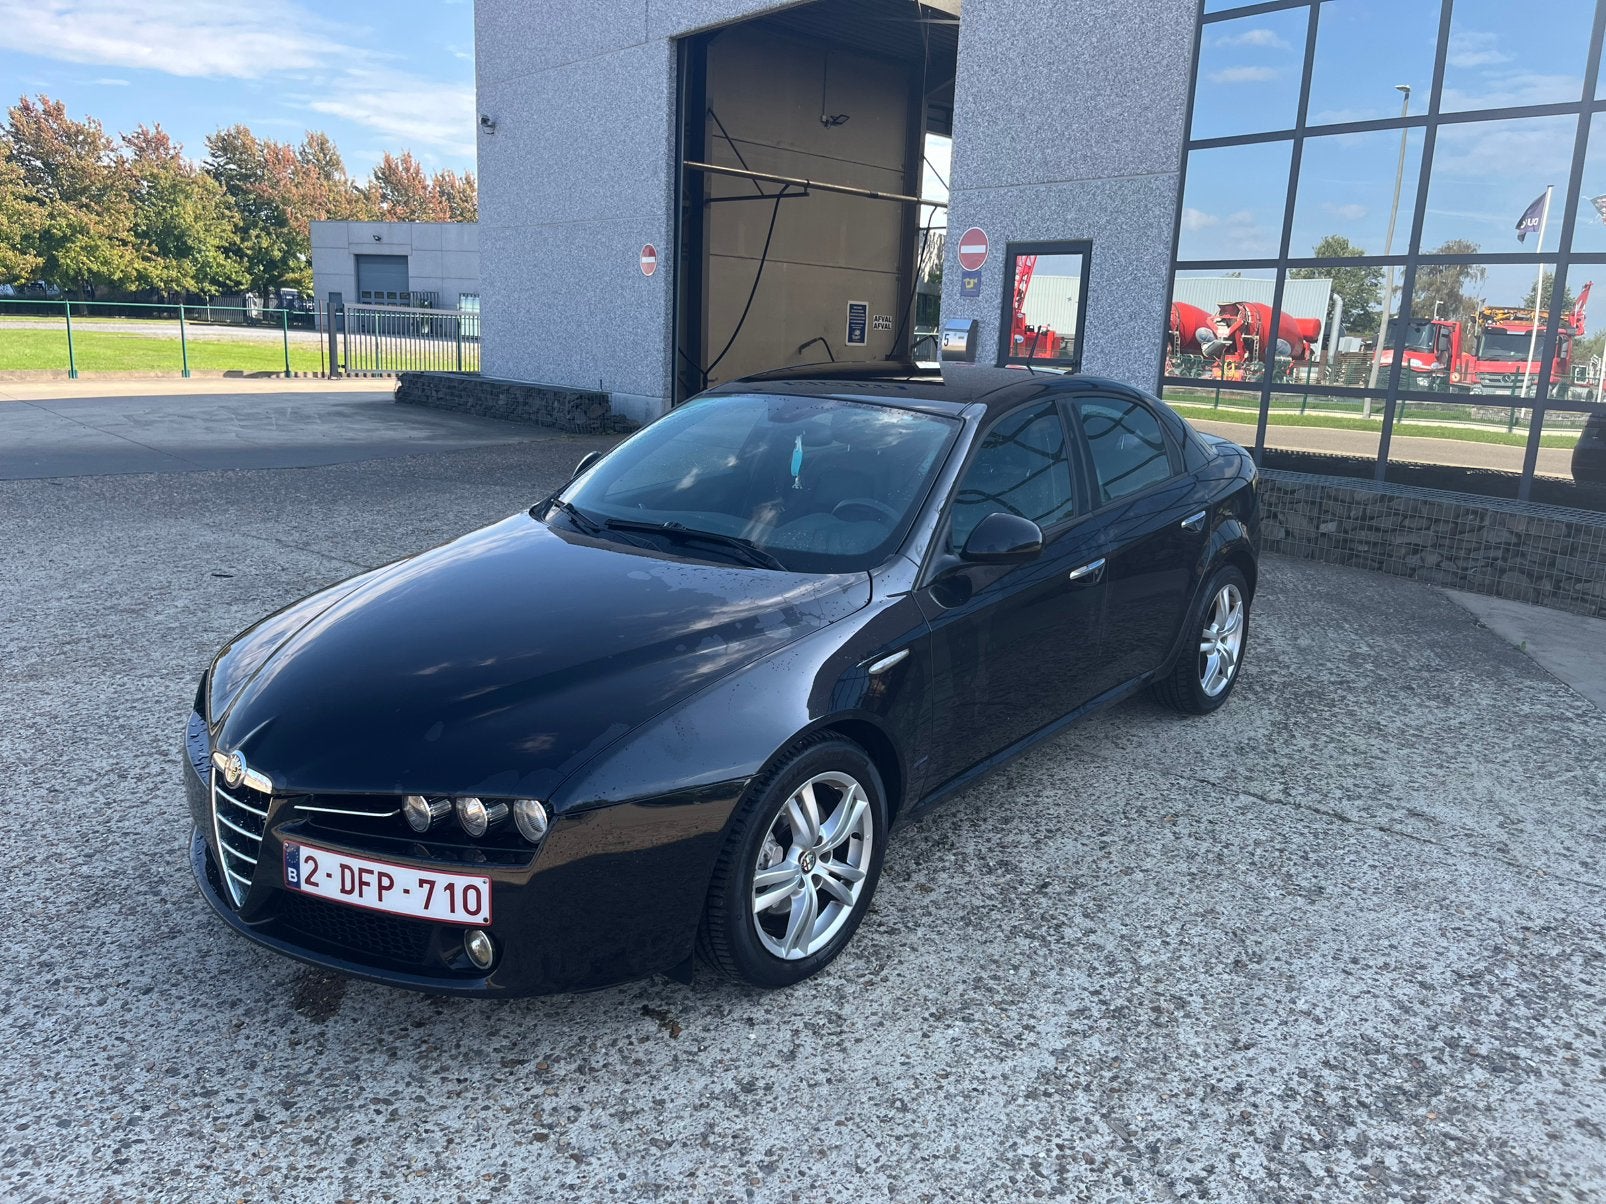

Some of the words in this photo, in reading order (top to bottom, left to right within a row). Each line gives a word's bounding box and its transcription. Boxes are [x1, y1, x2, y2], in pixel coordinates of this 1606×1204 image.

[943, 333, 949, 347] 5
[287, 866, 298, 883] B
[303, 855, 482, 916] 2-DFP-710
